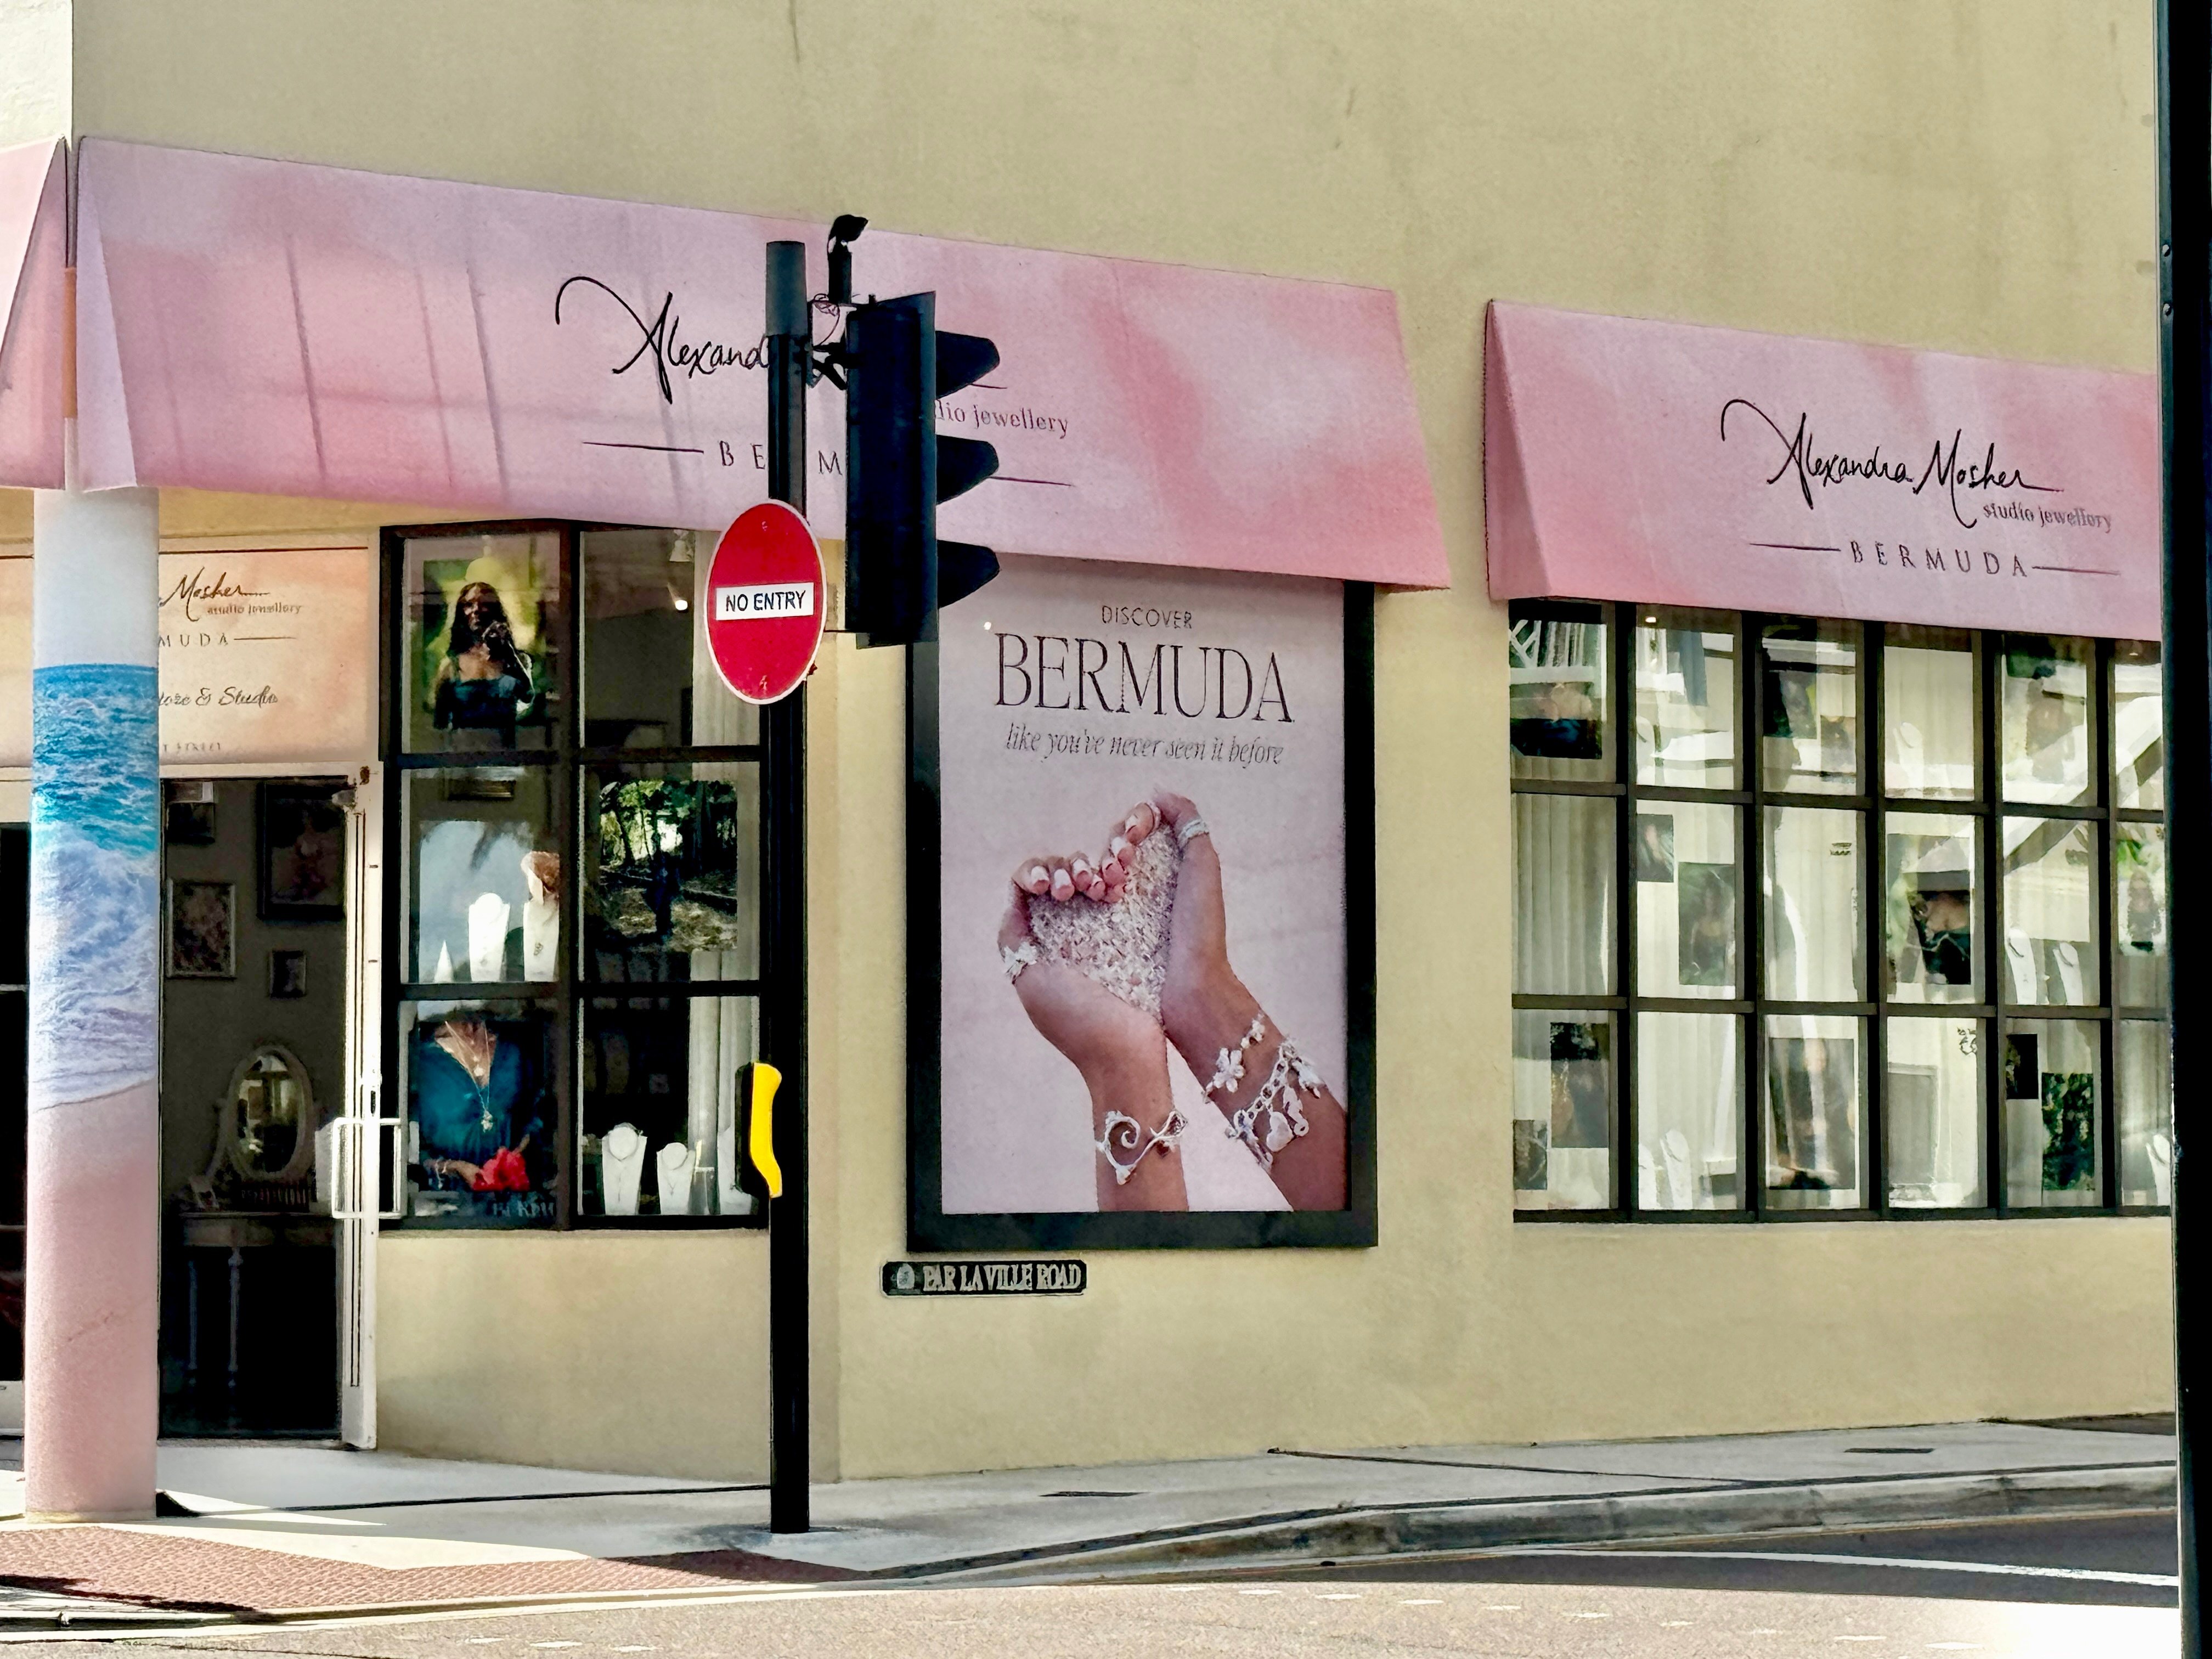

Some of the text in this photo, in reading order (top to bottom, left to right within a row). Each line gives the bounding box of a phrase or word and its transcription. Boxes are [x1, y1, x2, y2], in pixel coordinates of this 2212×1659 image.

[556, 276, 769, 404] Alexand
[973, 404, 1068, 439] jewellery
[1721, 399, 2065, 529] Alexandra Mosher
[1983, 501, 2112, 534] studio jewellery
[1849, 540, 2028, 578] BERMUDA
[160, 566, 271, 622] Mosher
[725, 590, 806, 612] NO ENTRY
[1101, 605, 1193, 630] DISCOVER
[158, 632, 228, 647] MUDA
[995, 632, 1295, 724] BERMUDA
[159, 691, 191, 707] tore
[195, 687, 213, 707] &
[1006, 721, 1284, 769] like you've never seen it before
[922, 1262, 1082, 1292] PAR LA VILLE ROAD
